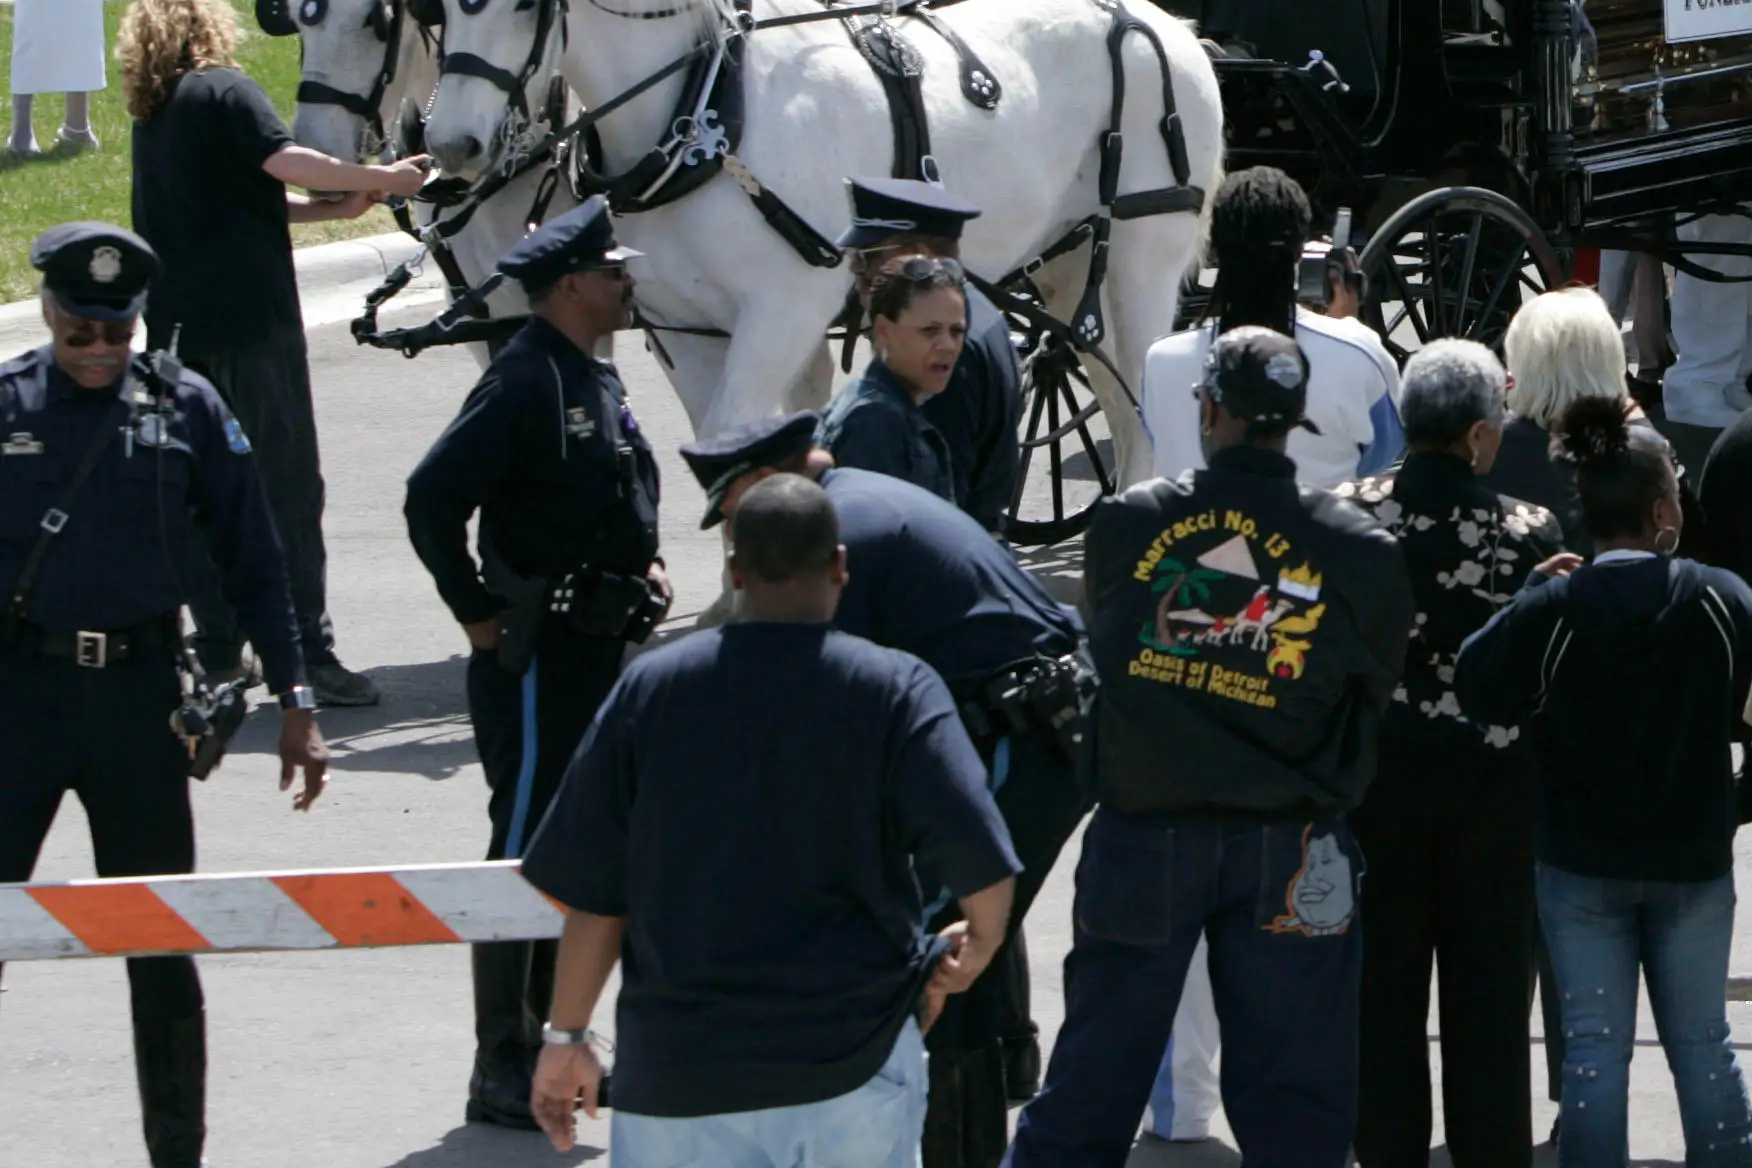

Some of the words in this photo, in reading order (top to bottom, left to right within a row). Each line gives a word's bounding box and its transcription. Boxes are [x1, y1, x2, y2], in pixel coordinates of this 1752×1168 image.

[1133, 509, 1217, 582] Marracci
[1224, 510, 1260, 540] No.
[1264, 533, 1292, 559] 13
[1128, 660, 1183, 685] Desert
[1185, 676, 1205, 689] of
[1207, 678, 1277, 709] Michigan
[1140, 648, 1185, 671] Oasis
[1189, 661, 1208, 675] of
[1211, 664, 1270, 692] Detroit
